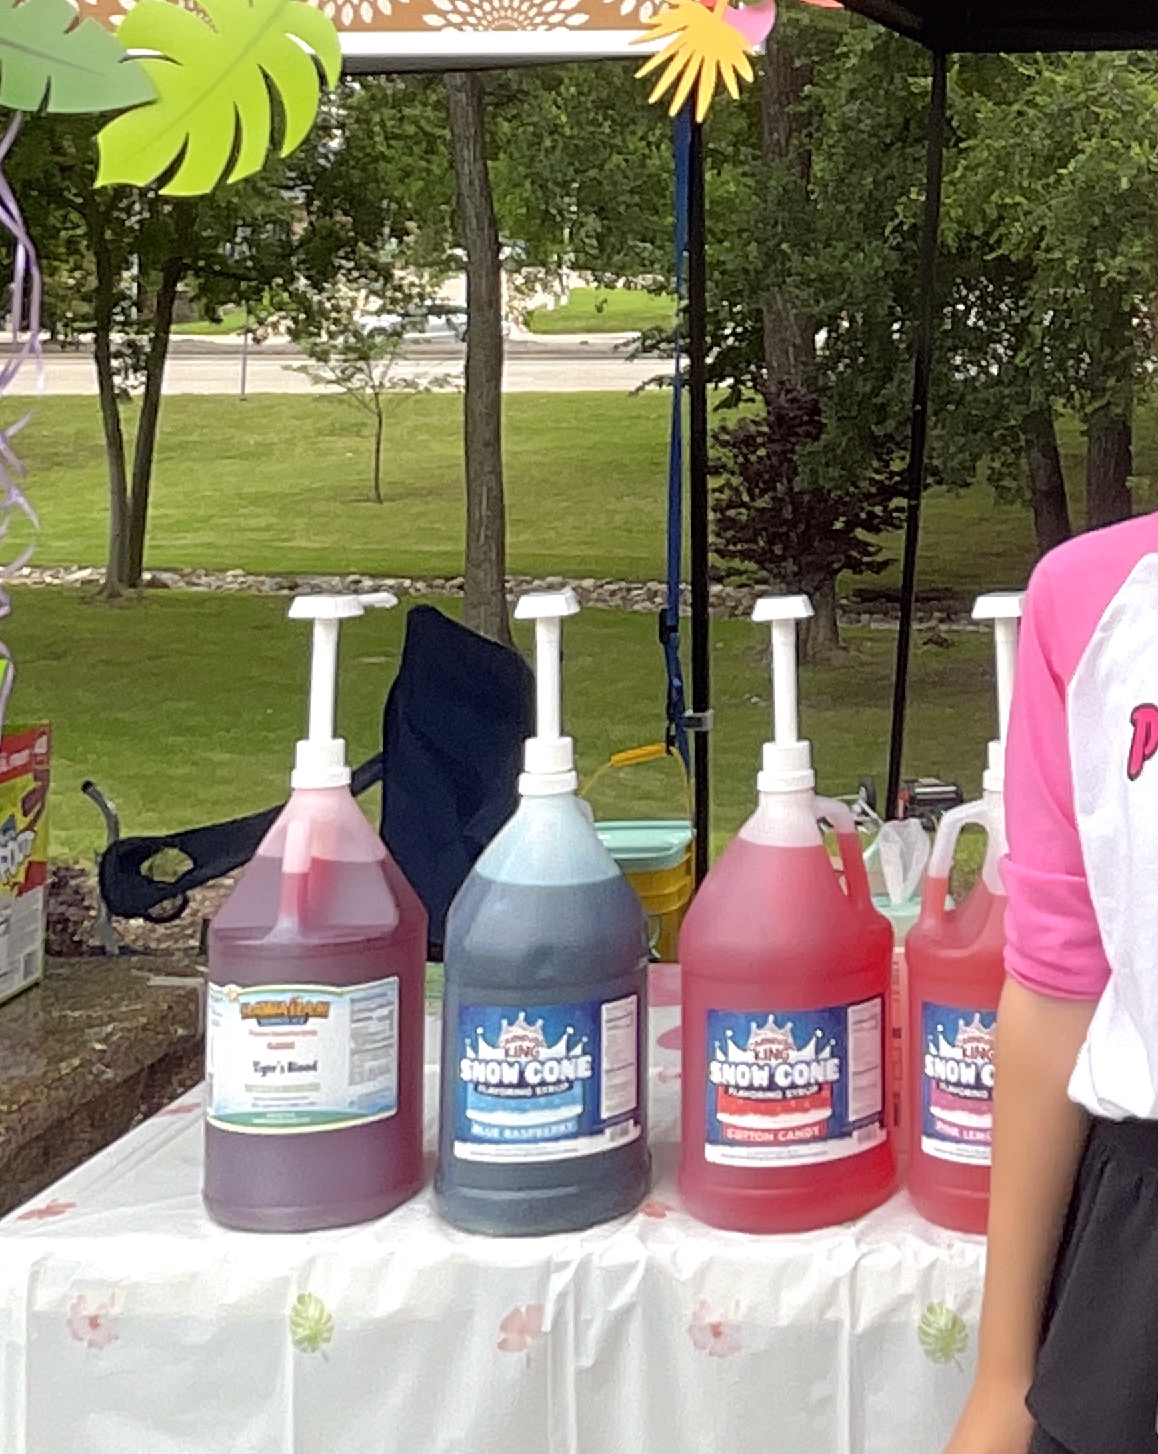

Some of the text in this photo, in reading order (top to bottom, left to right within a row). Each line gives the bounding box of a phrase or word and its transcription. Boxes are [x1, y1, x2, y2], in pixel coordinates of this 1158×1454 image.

[460, 1055, 593, 1084] SNOW CONE
[710, 1058, 840, 1087] SNOW CONE
[924, 1054, 981, 1086] SNOW
[727, 1125, 820, 1141] COTTON CANDY
